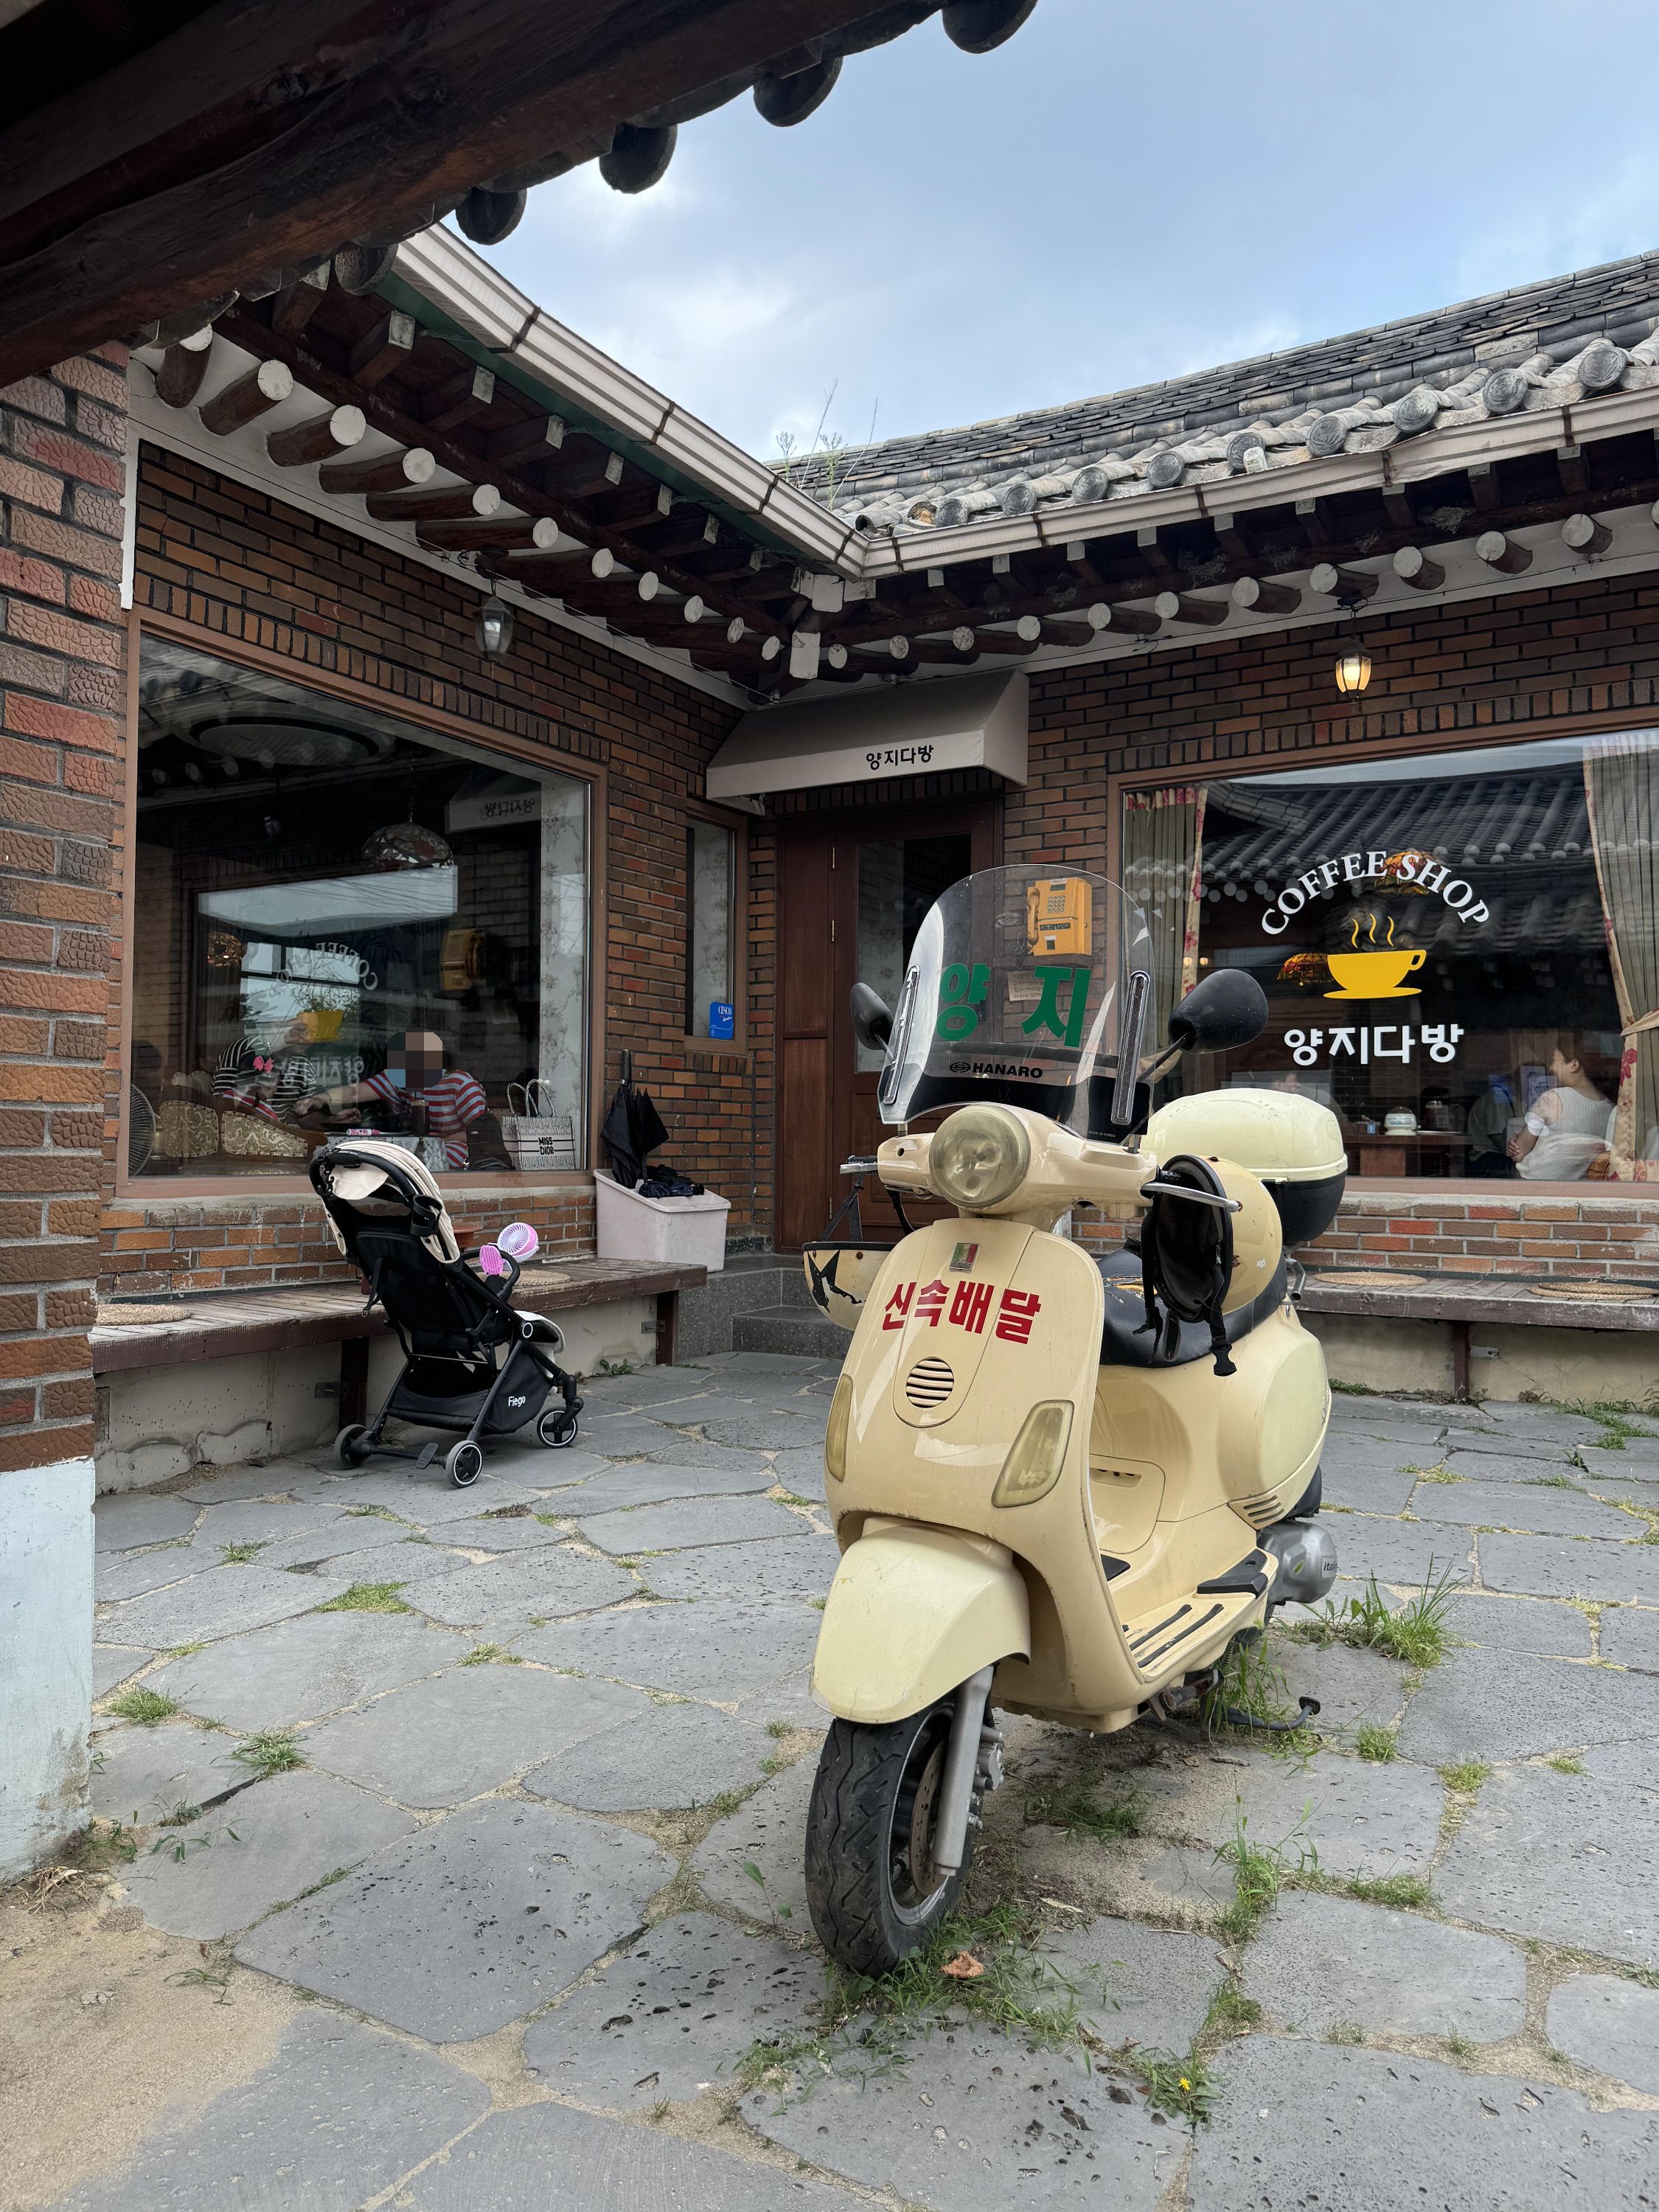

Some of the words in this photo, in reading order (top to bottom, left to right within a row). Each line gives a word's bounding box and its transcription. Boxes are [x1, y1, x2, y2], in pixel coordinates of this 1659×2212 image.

[866, 745, 933, 770] 양지다방
[1262, 851, 1387, 935] COFFEE
[1396, 854, 1489, 923] SHOP
[1284, 1023, 1464, 1066] 양지다방
[973, 1062, 1043, 1078] HANARO
[538, 1136, 553, 1146] MISS
[539, 1146, 554, 1155] DIOR
[882, 1279, 1042, 1345] 신속배달
[508, 1396, 526, 1407] Fiego
